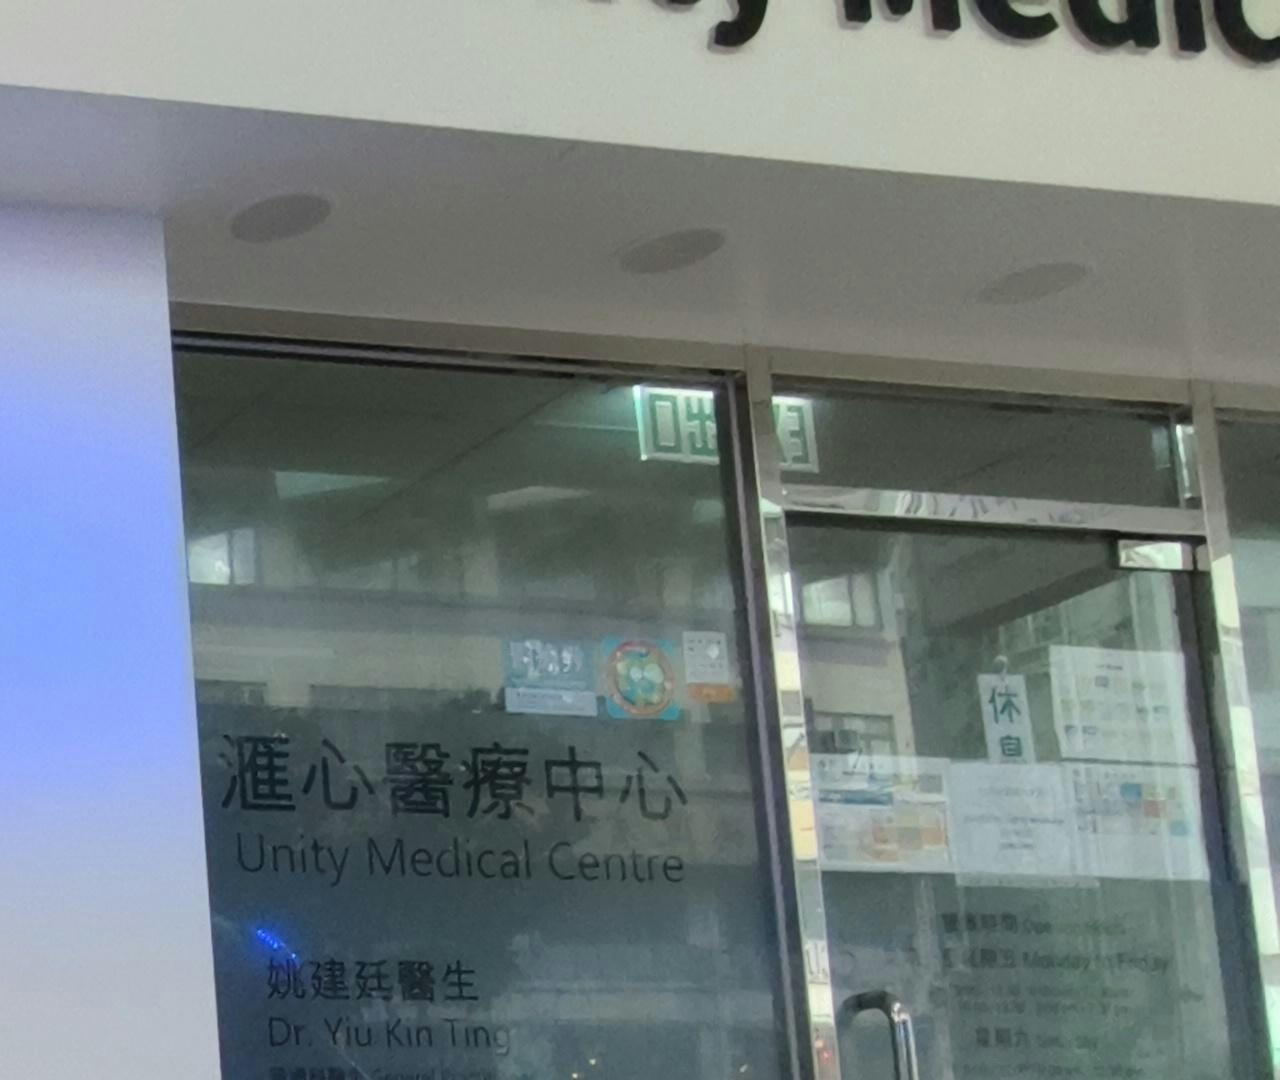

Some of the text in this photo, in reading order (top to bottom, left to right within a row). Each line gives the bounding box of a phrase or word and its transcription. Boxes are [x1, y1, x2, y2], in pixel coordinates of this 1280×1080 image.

[236, 833, 686, 887] Unity Medical Centre
[267, 957, 480, 1003] 姚建廷醫生
[268, 1017, 511, 1056] Dr. Yiu Kin Ting
